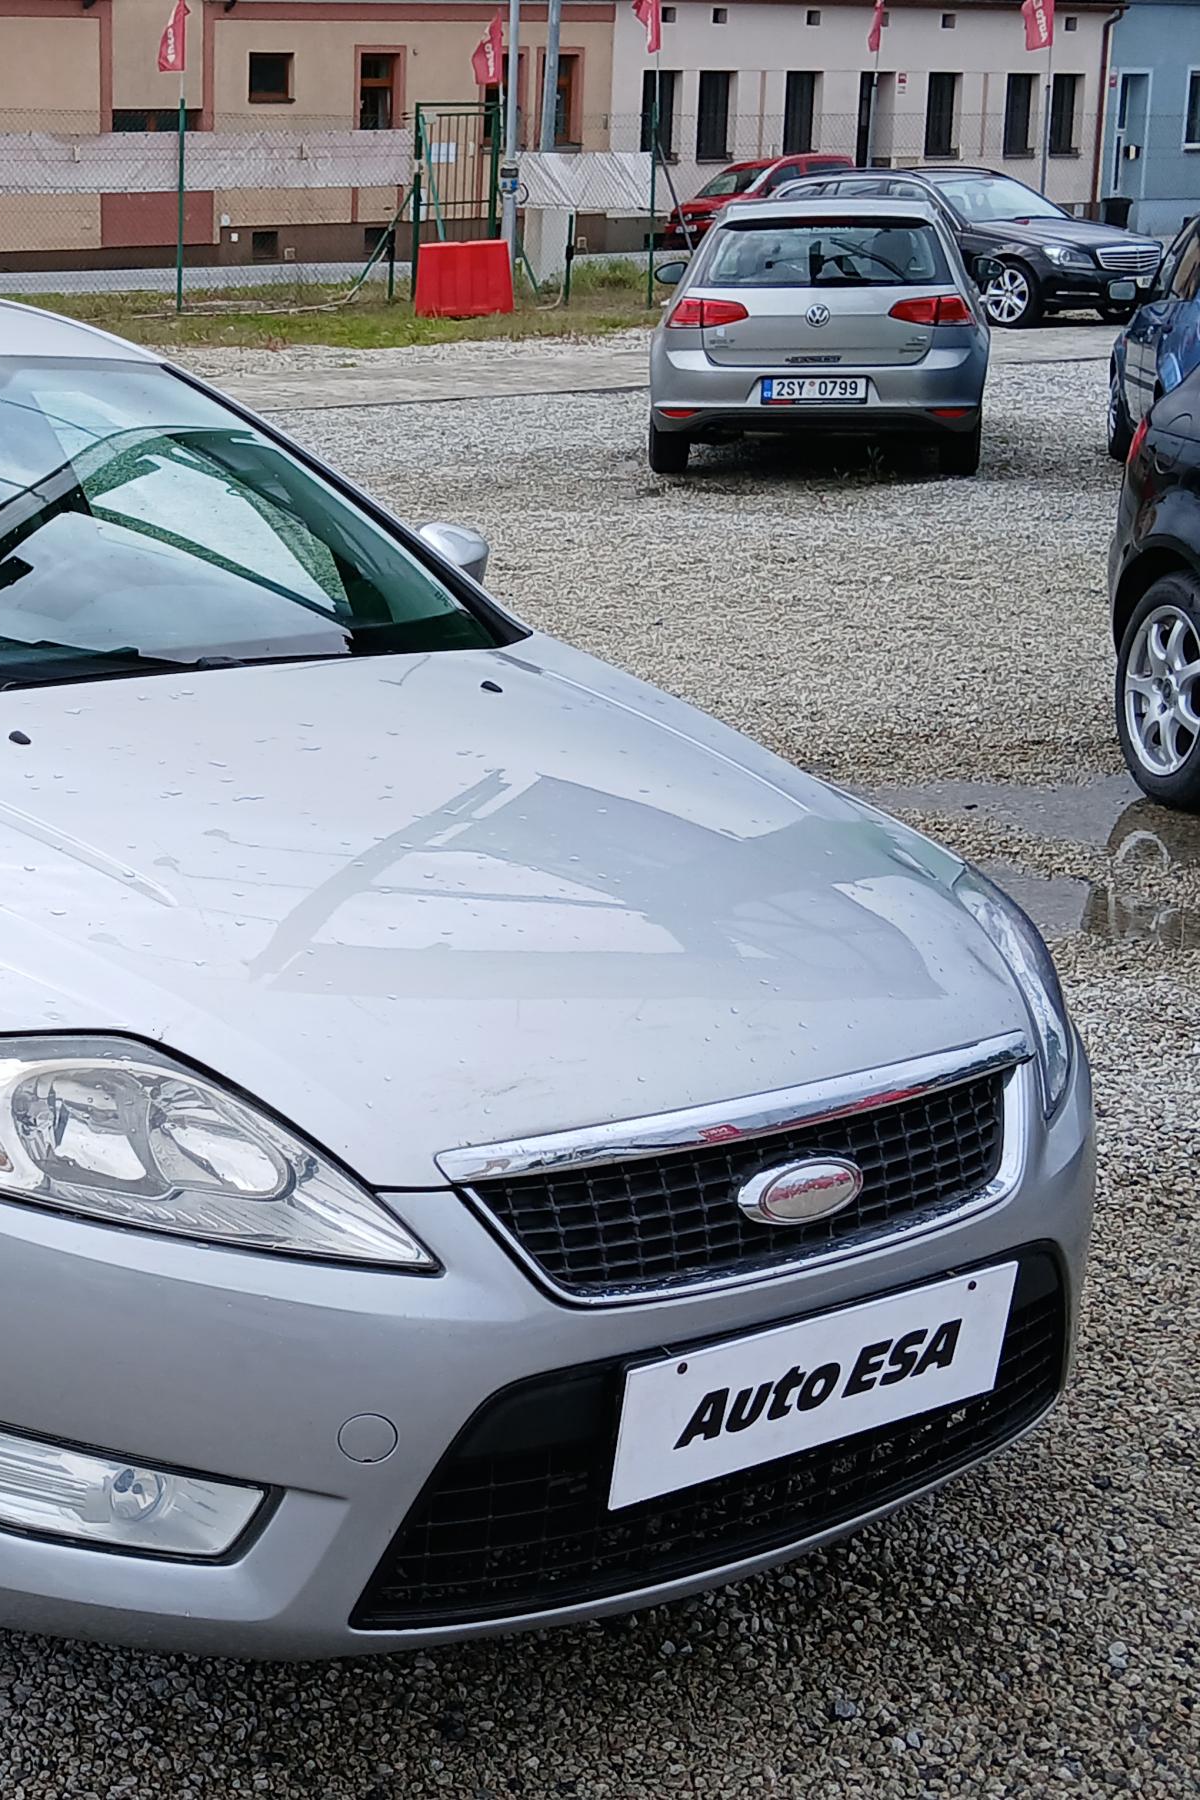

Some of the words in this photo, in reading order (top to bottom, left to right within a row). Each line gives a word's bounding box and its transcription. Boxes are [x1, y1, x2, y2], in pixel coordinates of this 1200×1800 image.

[776, 380, 806, 397] 2SY
[818, 380, 858, 396] 0799
[673, 1362, 841, 1450] Auto
[841, 1317, 963, 1399] ESA
